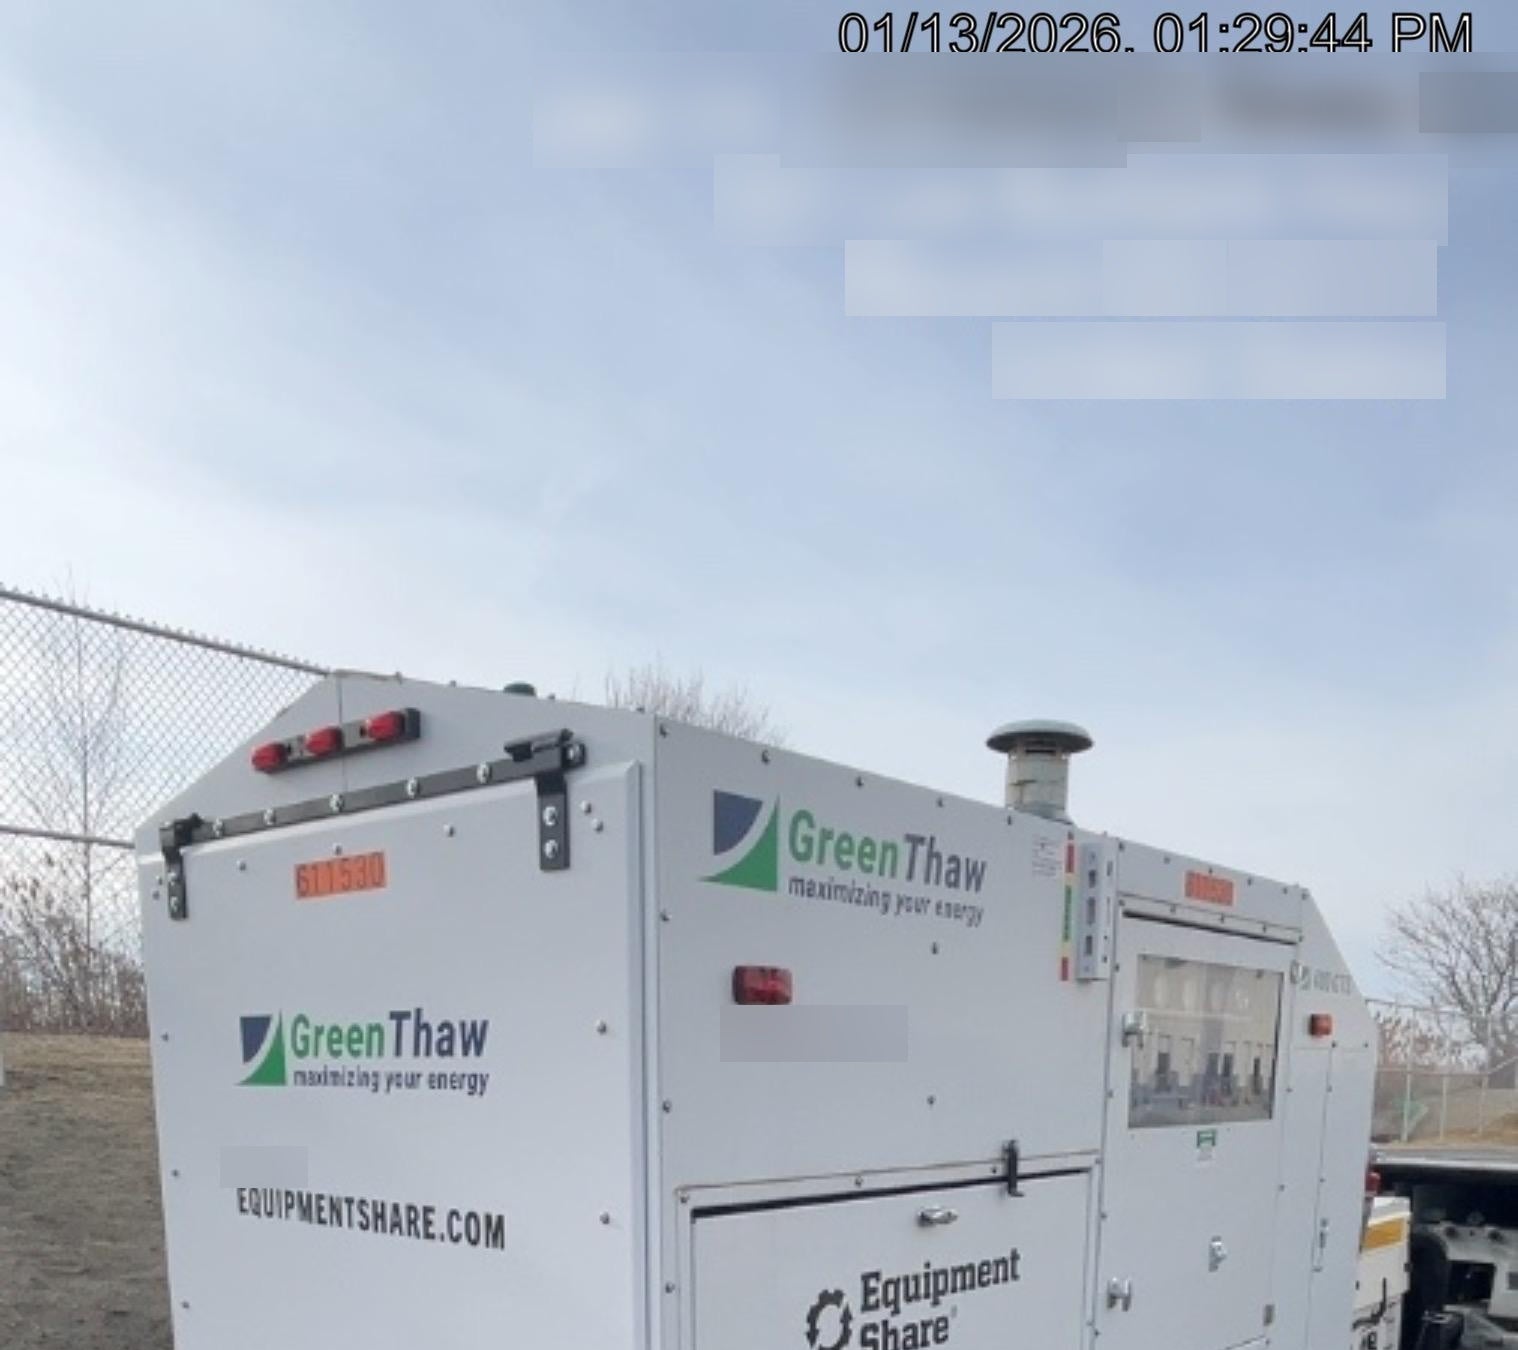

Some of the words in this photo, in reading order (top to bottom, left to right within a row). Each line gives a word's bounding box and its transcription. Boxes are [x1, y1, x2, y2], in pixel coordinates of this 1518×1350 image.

[296, 851, 386, 899] 611530
[788, 808, 988, 893] GreenThaw
[788, 876, 892, 916] maximizing
[894, 893, 931, 917] your
[935, 899, 985, 928] energy
[290, 1007, 489, 1058] GreenThaw
[293, 1065, 379, 1093] maximizing
[384, 1070, 423, 1094] your
[427, 1070, 490, 1096] energy
[236, 1187, 505, 1251] EQUIPMENTSHARE.COM
[860, 1247, 1021, 1317] Equipment
